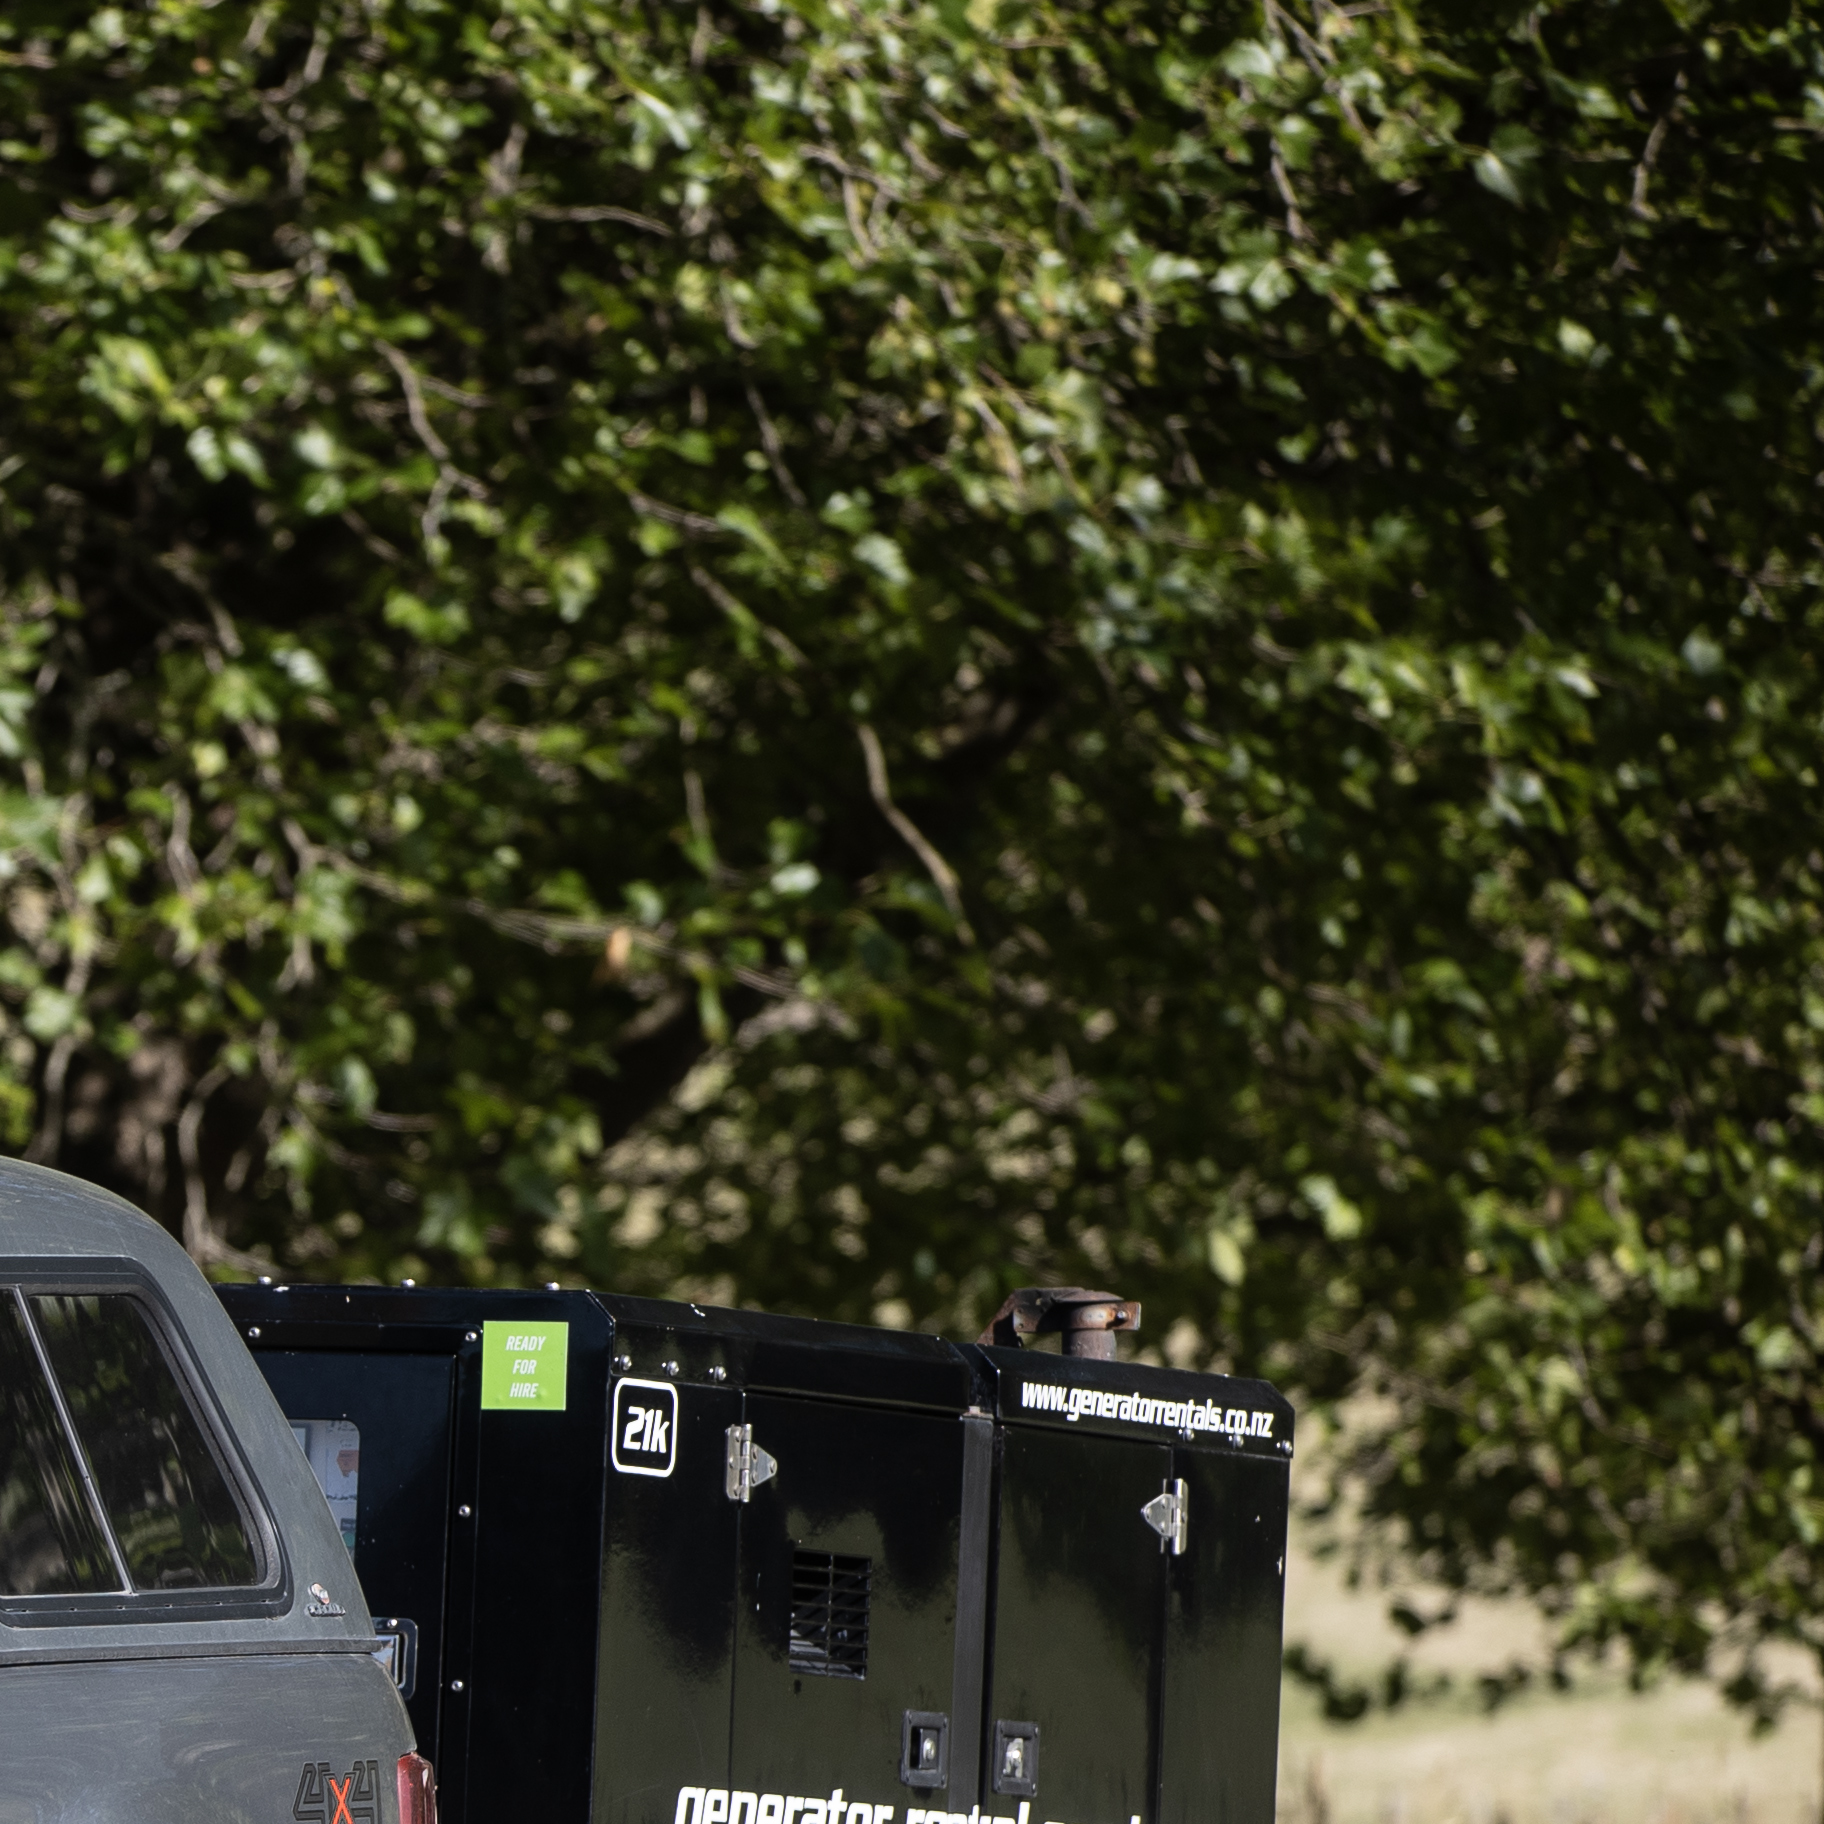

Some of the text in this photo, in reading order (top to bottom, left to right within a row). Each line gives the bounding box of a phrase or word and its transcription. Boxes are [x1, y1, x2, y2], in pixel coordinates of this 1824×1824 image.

[505, 1335, 547, 1351] READY
[512, 1359, 537, 1375] FOR
[509, 1382, 540, 1398] HIRE
[1021, 1381, 1275, 1438] www.generatorrentals.co.nz
[622, 1405, 671, 1454] 21k
